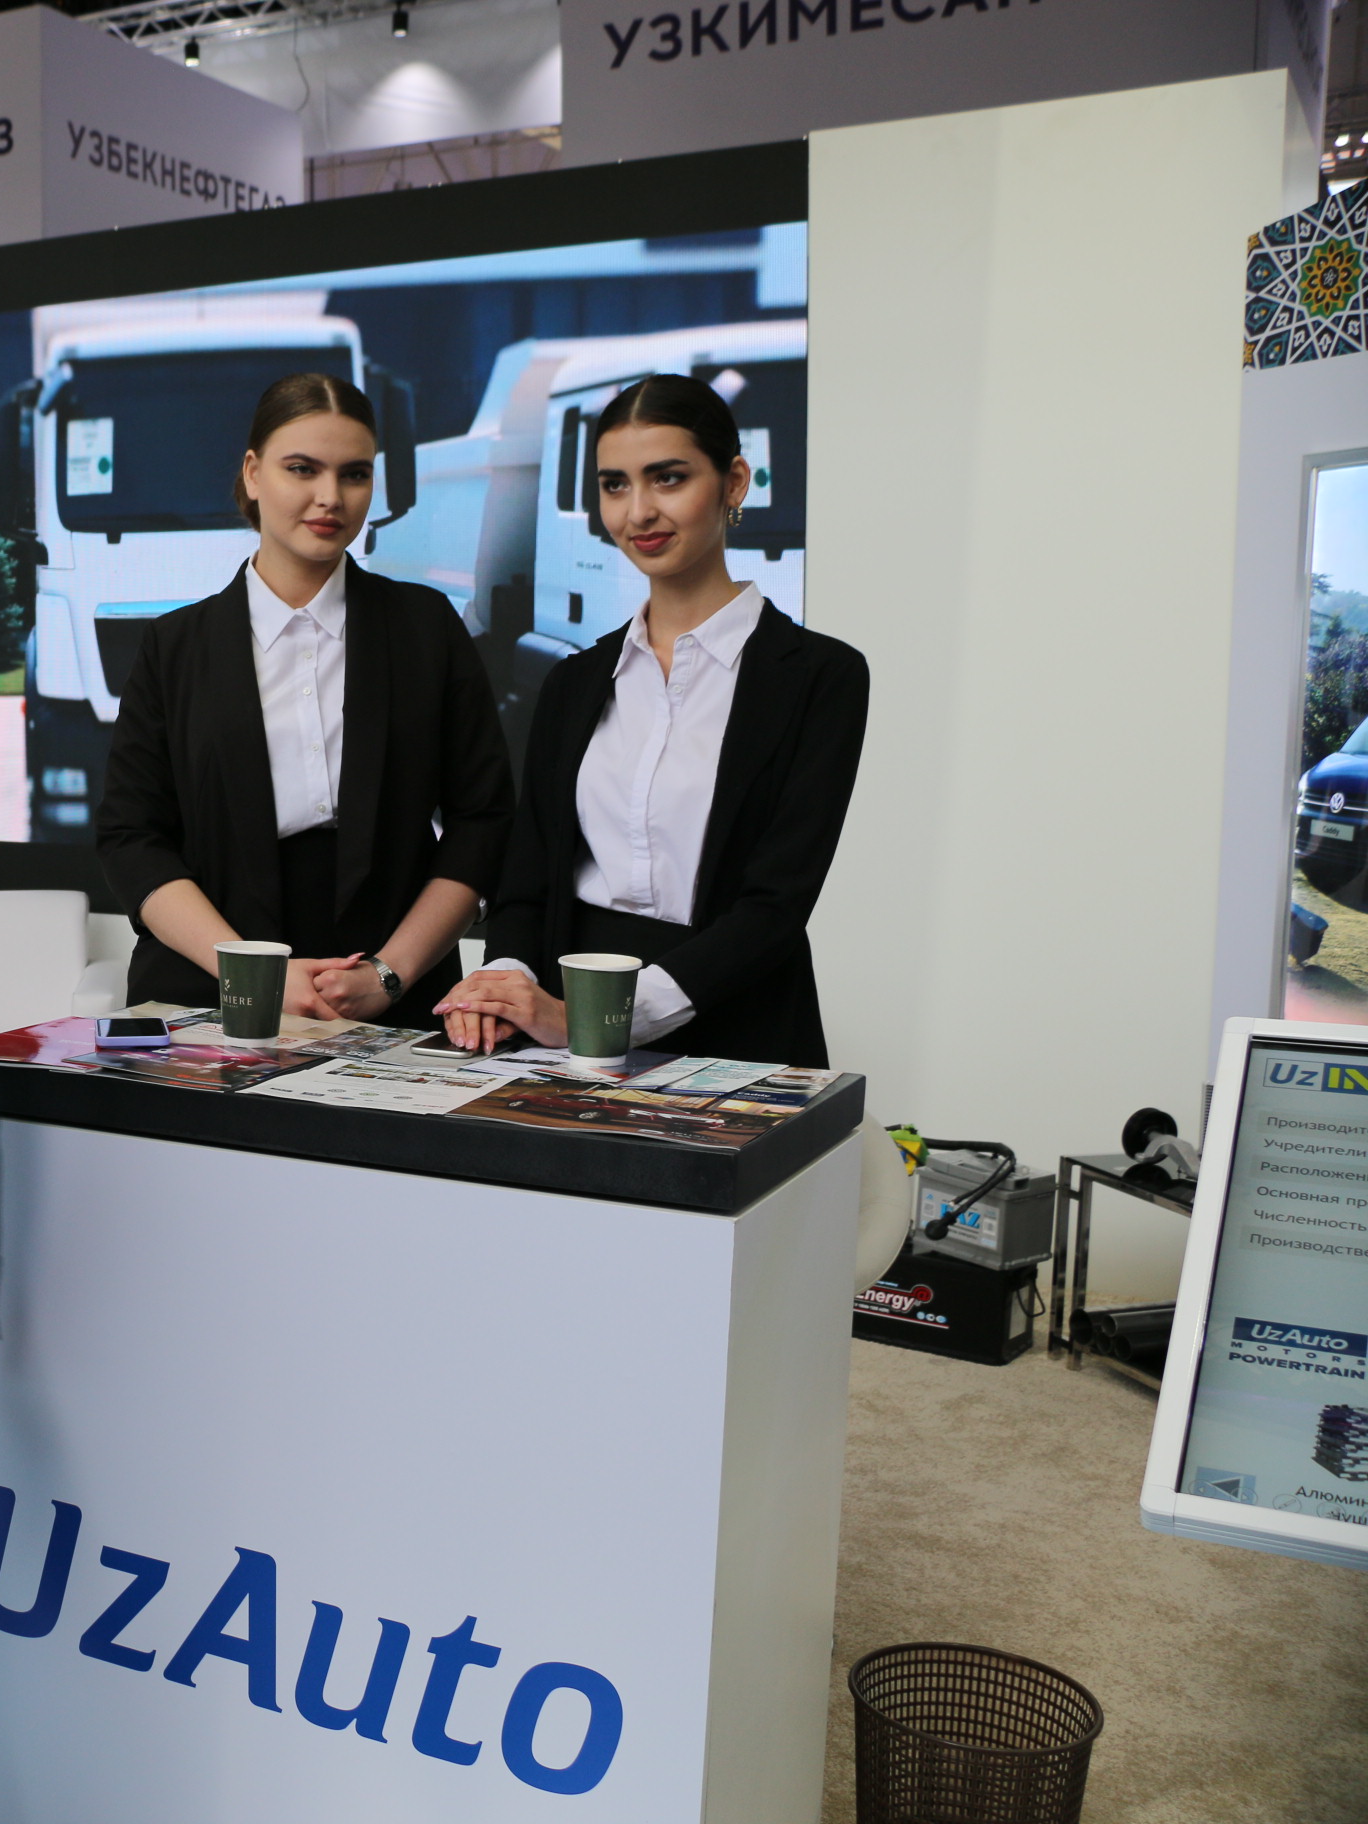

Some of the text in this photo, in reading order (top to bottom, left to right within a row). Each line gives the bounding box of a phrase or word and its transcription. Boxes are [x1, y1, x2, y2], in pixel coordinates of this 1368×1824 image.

[603, 0, 1034, 70] УЗКИМЕ
[1263, 1138, 1366, 1158] Учредители
[1256, 1185, 1339, 1205] Основная
[1253, 1208, 1367, 1232] Численность
[856, 1288, 915, 1311] nergy
[1250, 1323, 1349, 1350] UzAuto
[1228, 1351, 1366, 1380] POWERTRAIN
[1230, 1341, 1366, 1366] MOTORS
